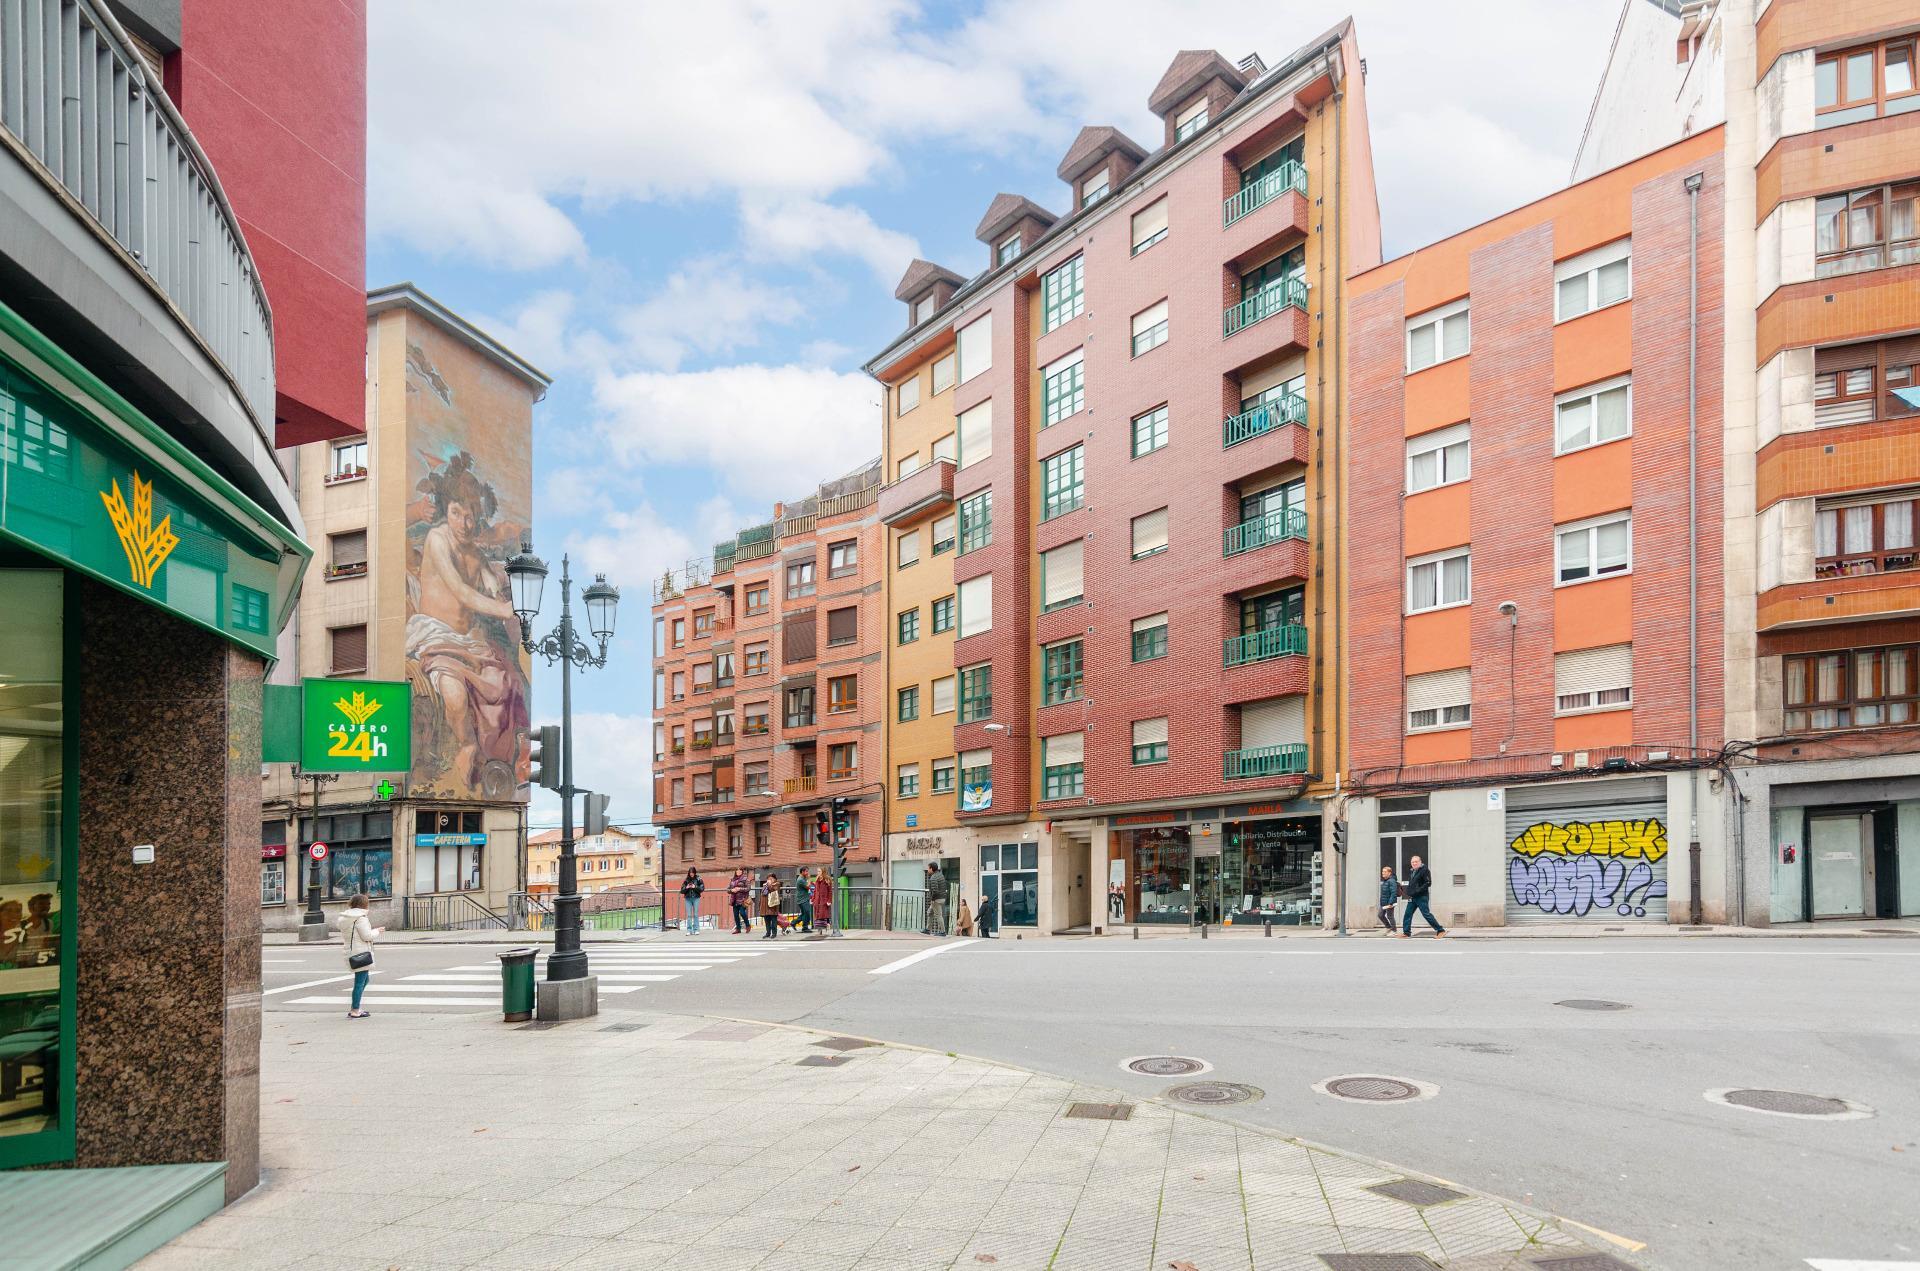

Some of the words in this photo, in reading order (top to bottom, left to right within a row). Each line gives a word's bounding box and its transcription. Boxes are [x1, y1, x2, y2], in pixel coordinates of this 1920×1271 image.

[328, 723, 388, 733] CAJERO
[328, 731, 388, 762] 24h
[1266, 829, 1307, 839] Distribución
[1261, 841, 1281, 849] Venta
